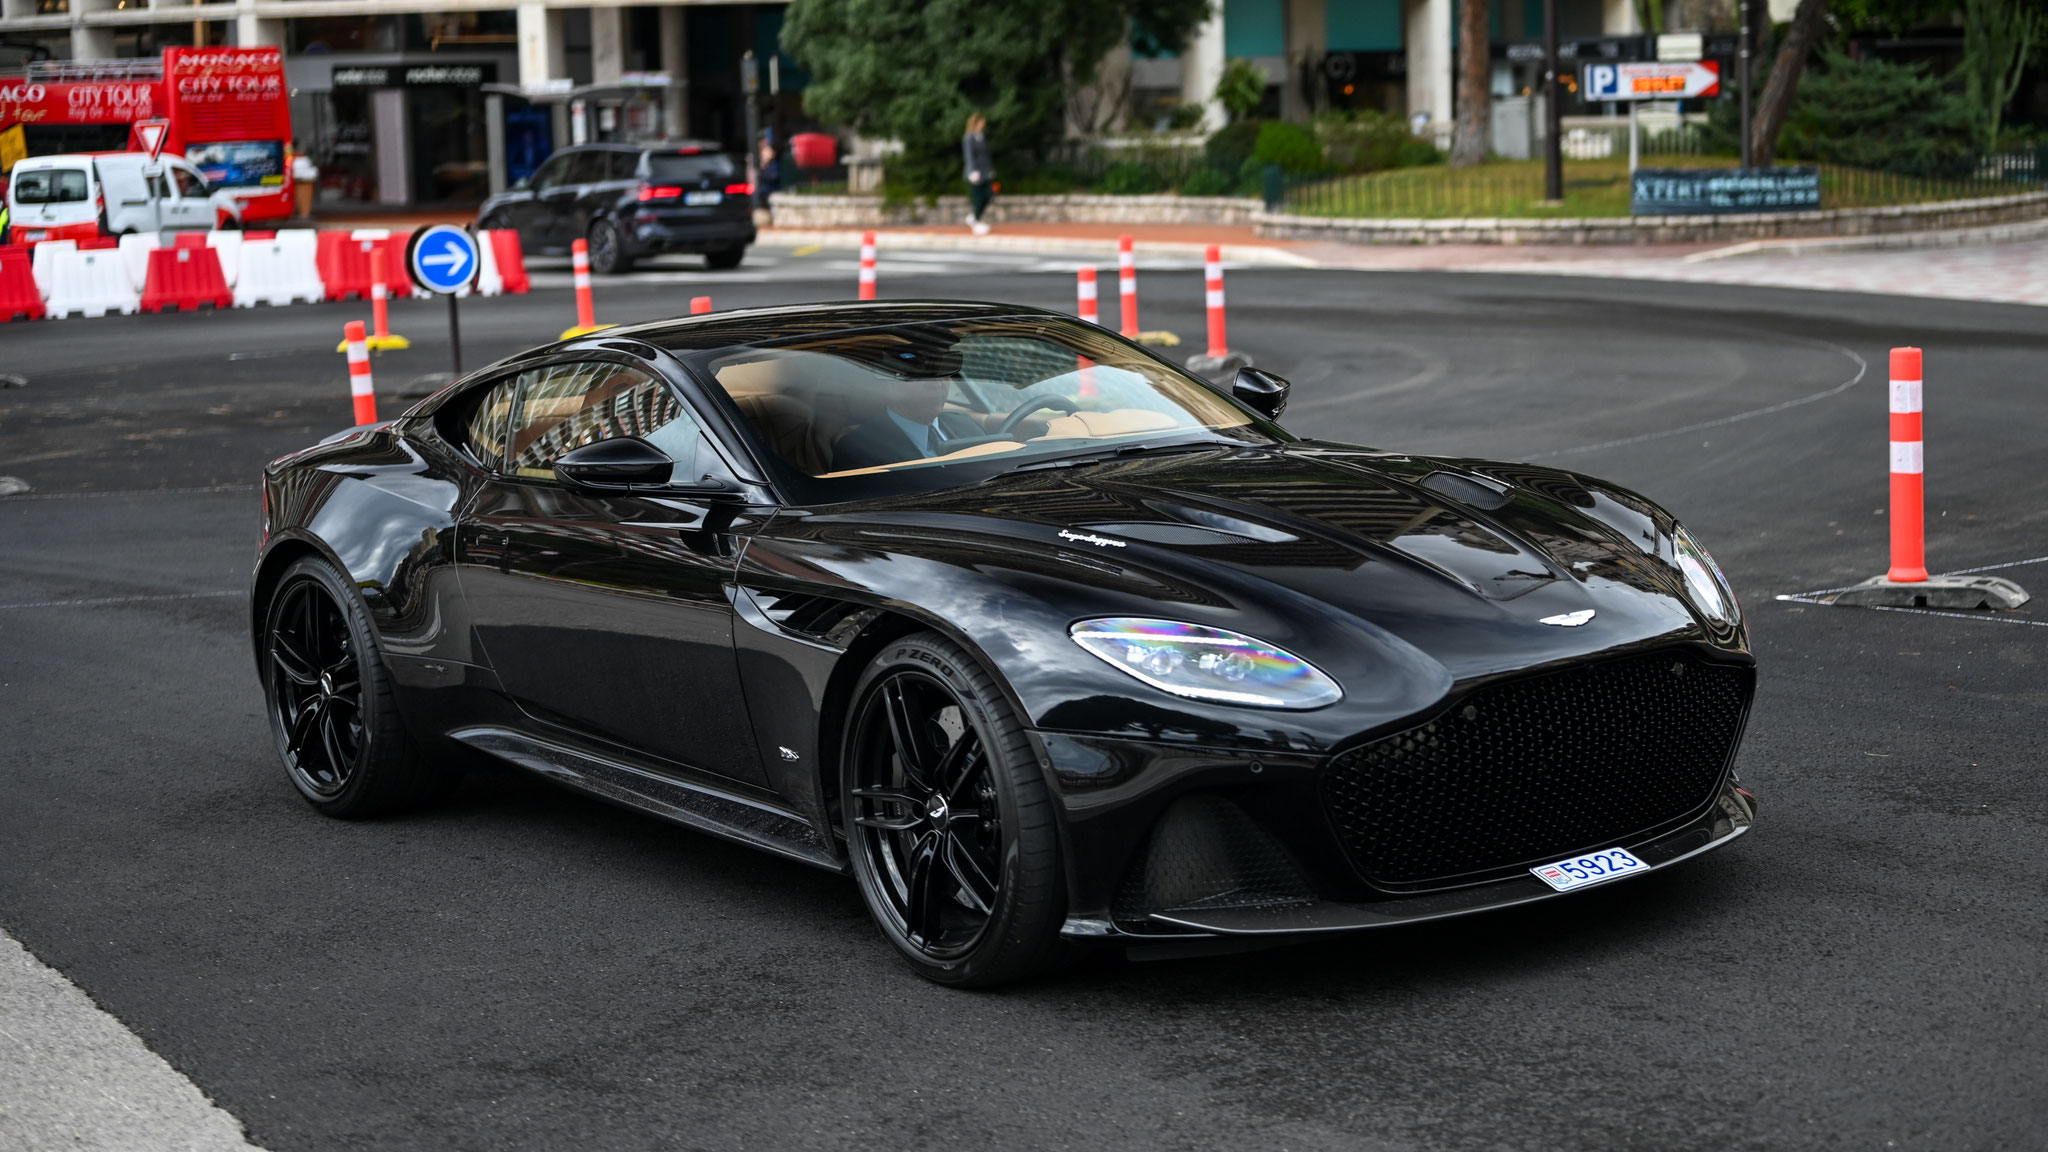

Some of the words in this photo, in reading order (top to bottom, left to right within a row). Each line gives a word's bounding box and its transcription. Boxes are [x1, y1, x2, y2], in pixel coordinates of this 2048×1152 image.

[178, 52, 281, 66] MONACO
[178, 76, 222, 93] CITY
[225, 75, 281, 93] TOUR
[1593, 64, 1614, 95] P
[68, 85, 104, 108] CITY
[105, 84, 152, 107] TOUR
[895, 648, 906, 660] P
[908, 648, 955, 678] ZERO
[1559, 851, 1638, 879] 5923
